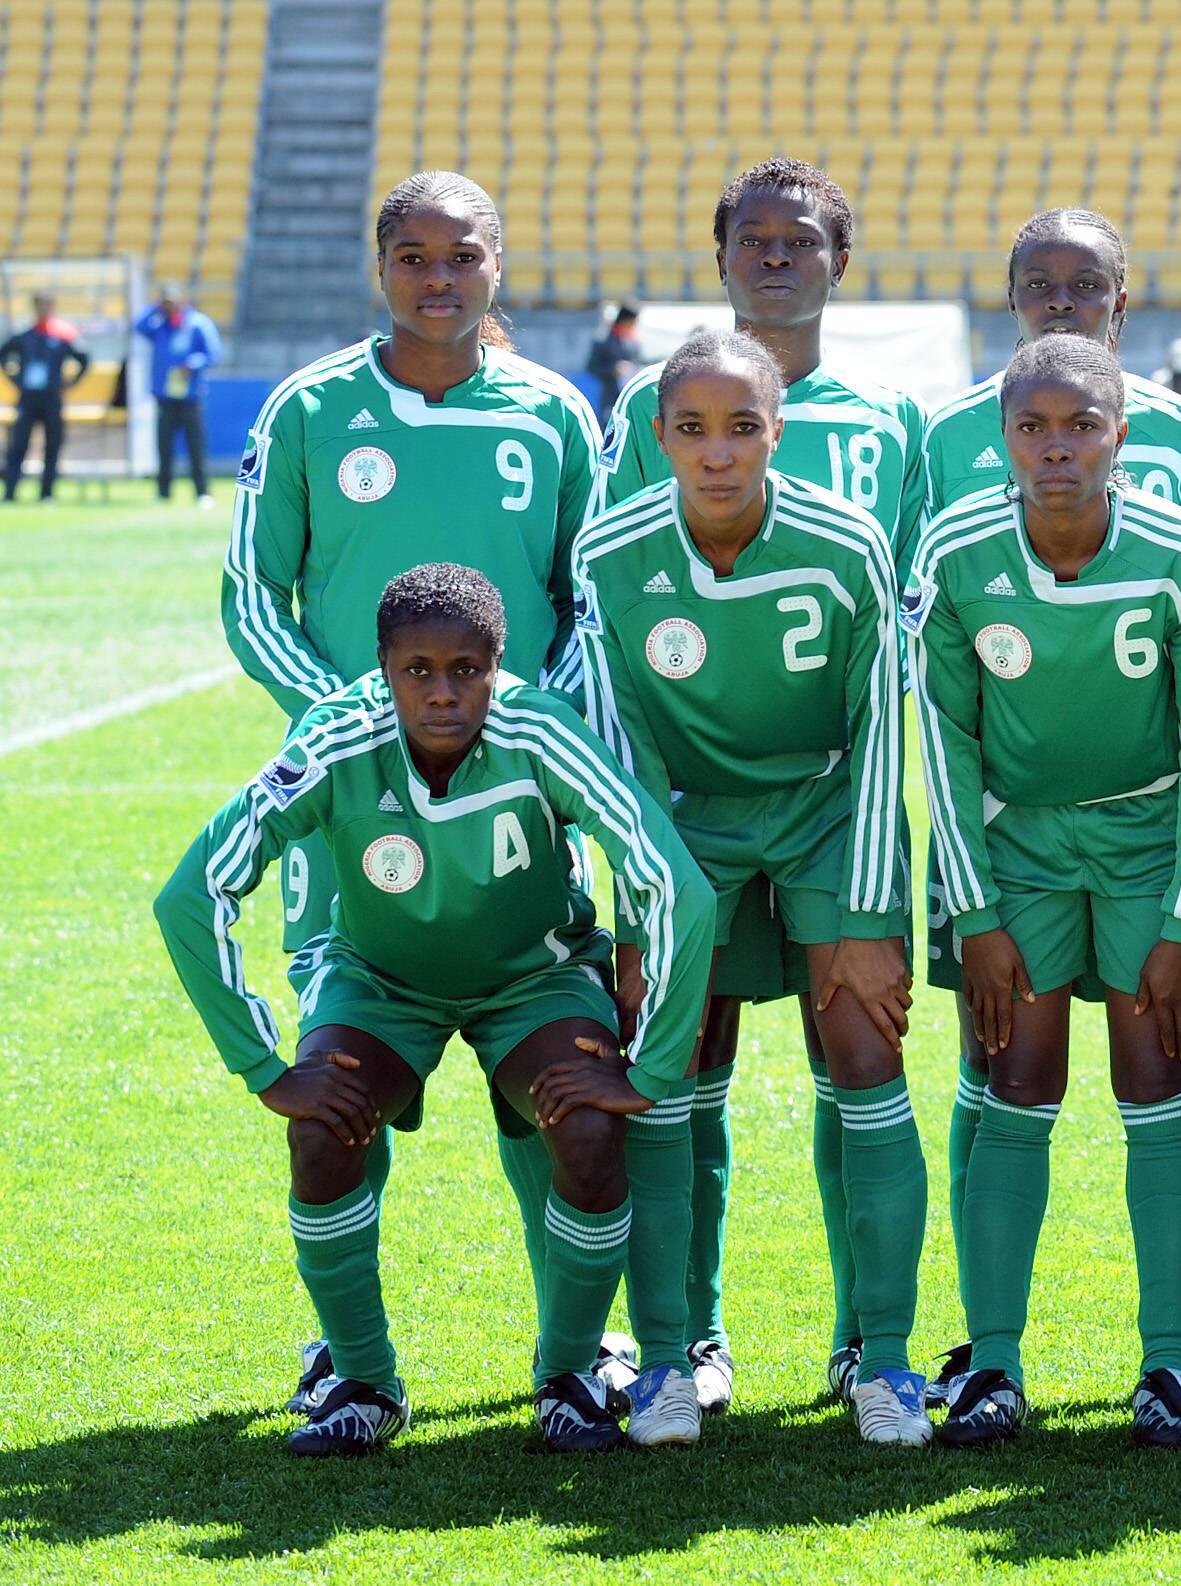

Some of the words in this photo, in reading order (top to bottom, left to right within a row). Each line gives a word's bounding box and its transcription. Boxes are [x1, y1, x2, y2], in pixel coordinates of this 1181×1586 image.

[347, 420, 380, 430] adidas
[495, 439, 534, 512] 9
[827, 432, 882, 509] 18
[972, 459, 1003, 468] adidas
[643, 585, 676, 593] adidas
[984, 586, 1017, 596] adidas
[684, 621, 705, 662] ASSOCIATION
[776, 595, 828, 672] 2
[1113, 608, 1158, 679] 6
[493, 811, 531, 878] 4
[286, 846, 309, 923] 9
